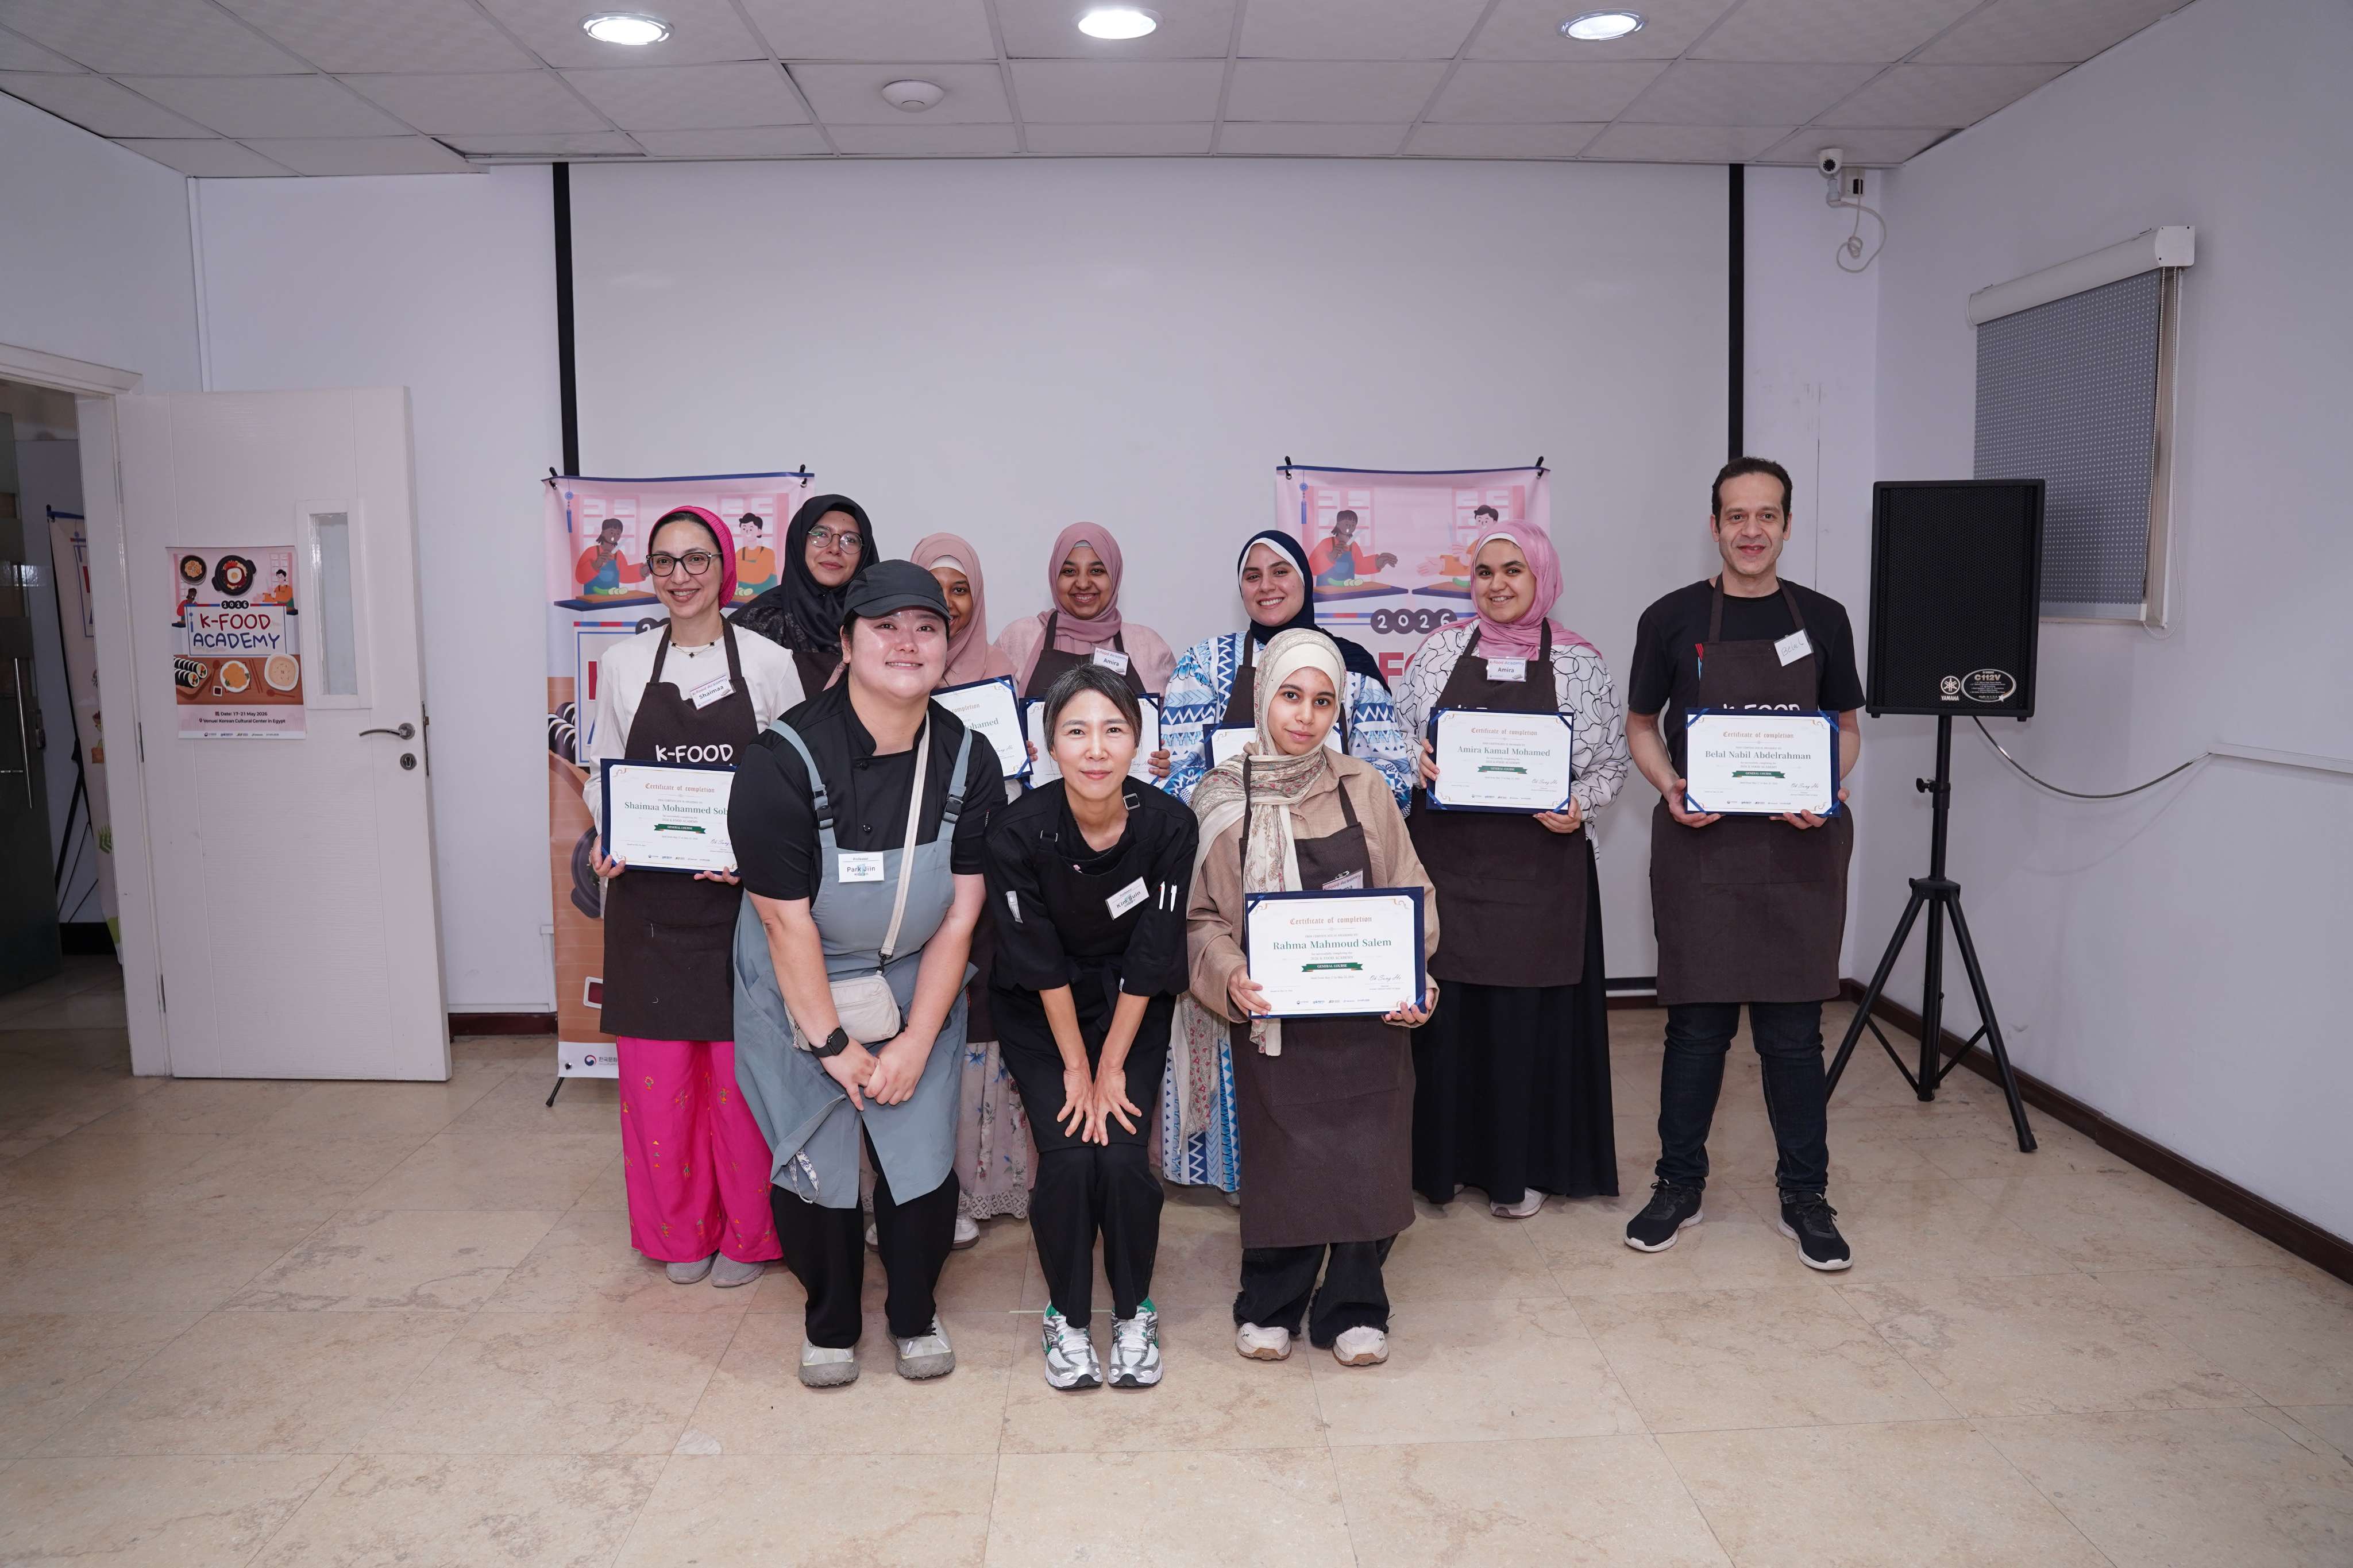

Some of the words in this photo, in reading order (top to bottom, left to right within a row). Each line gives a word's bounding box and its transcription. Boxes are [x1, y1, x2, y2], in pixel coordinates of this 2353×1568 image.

[200, 613, 271, 631] K-FOOD
[1377, 613, 1450, 629] 2026
[193, 632, 280, 649] ACADEMY
[1103, 658, 1119, 666] Amira
[699, 685, 724, 700] Shaimaa
[951, 703, 981, 713] completion
[965, 718, 999, 730] ohamed
[655, 744, 734, 763] K-FOOD
[1457, 746, 1482, 754] Amira
[1484, 747, 1509, 755] Kamal
[1512, 748, 1550, 756] Mohamed
[1706, 750, 1726, 758] Belal
[1729, 751, 1751, 759] Nabil
[645, 783, 674, 791] Certificate
[624, 801, 659, 812] Shaimaa
[662, 804, 711, 814] Mohammed
[1340, 874, 1361, 886] Academy
[1116, 899, 1128, 909] Kim
[1273, 941, 1307, 950] Rahma
[1310, 939, 1359, 949] Mahmoud
[1362, 938, 1391, 947] Salem
